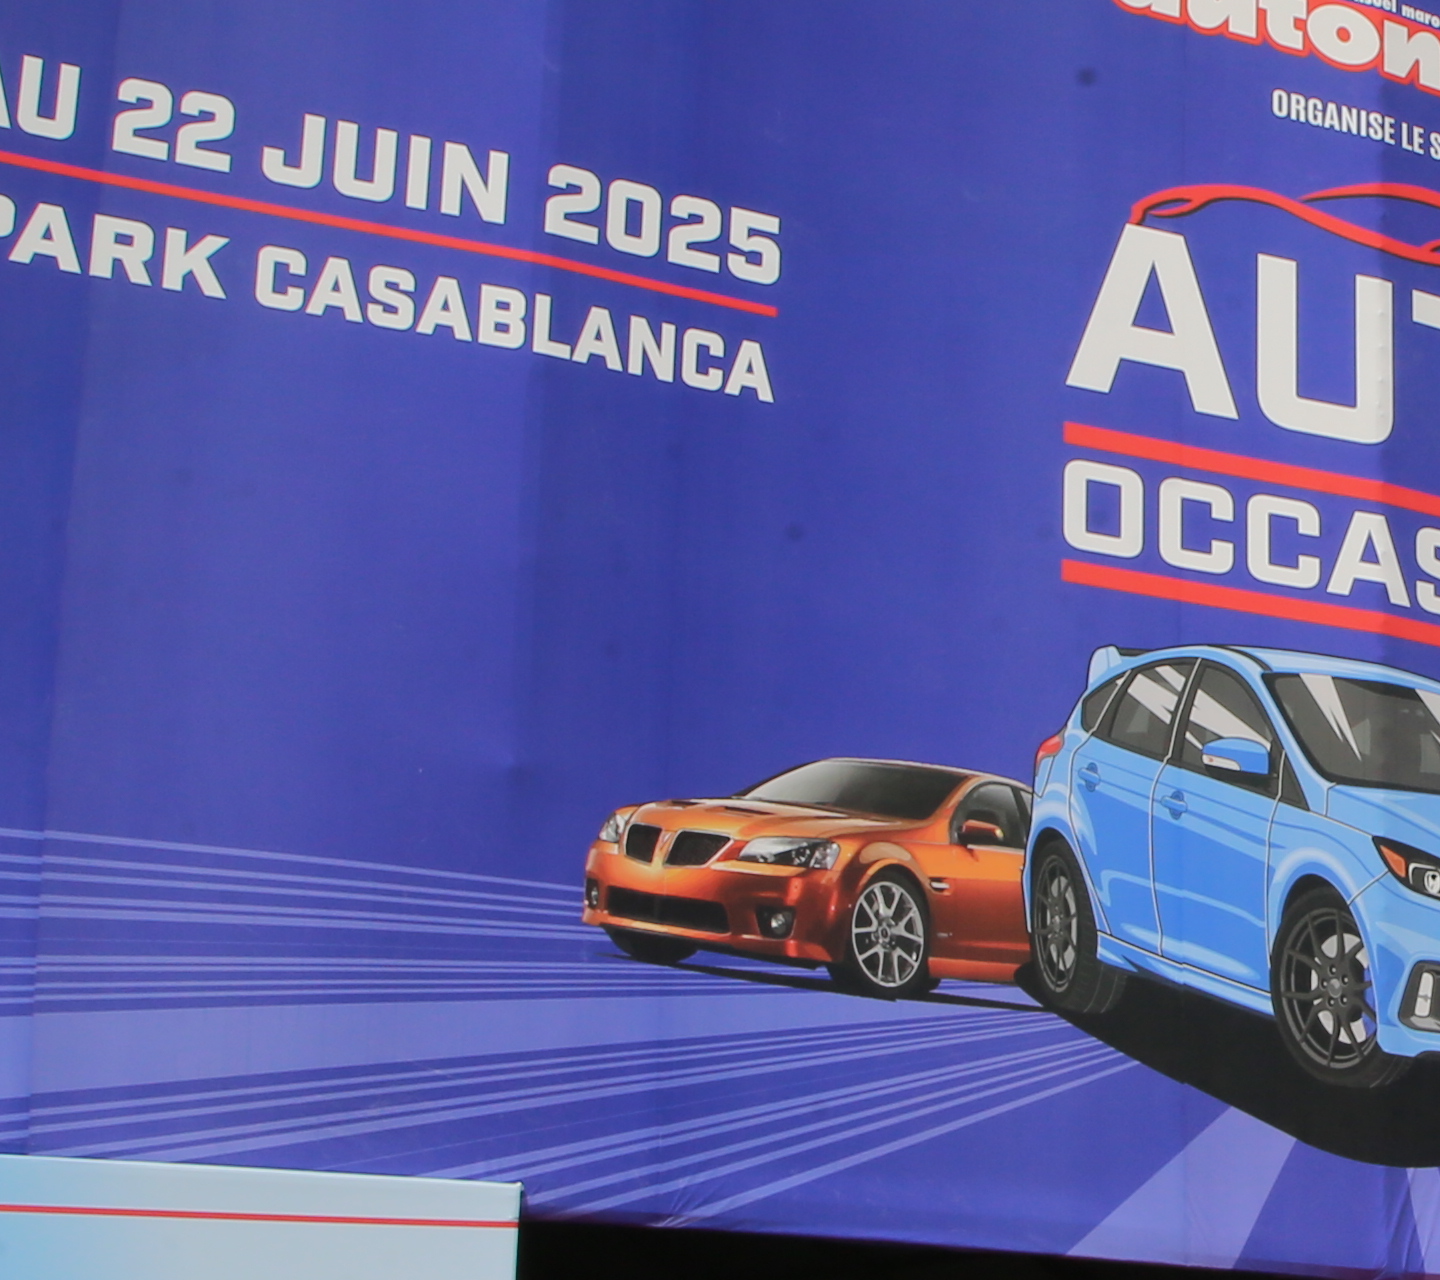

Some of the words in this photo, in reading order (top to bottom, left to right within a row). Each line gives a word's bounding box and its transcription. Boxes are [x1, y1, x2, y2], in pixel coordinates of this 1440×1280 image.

[111, 78, 236, 175] 22
[260, 113, 510, 225] JUIN
[543, 163, 781, 287] 2025
[1272, 88, 1396, 144] ORGANISE
[1401, 121, 1424, 155] LE
[254, 243, 777, 405] CASABLANCA
